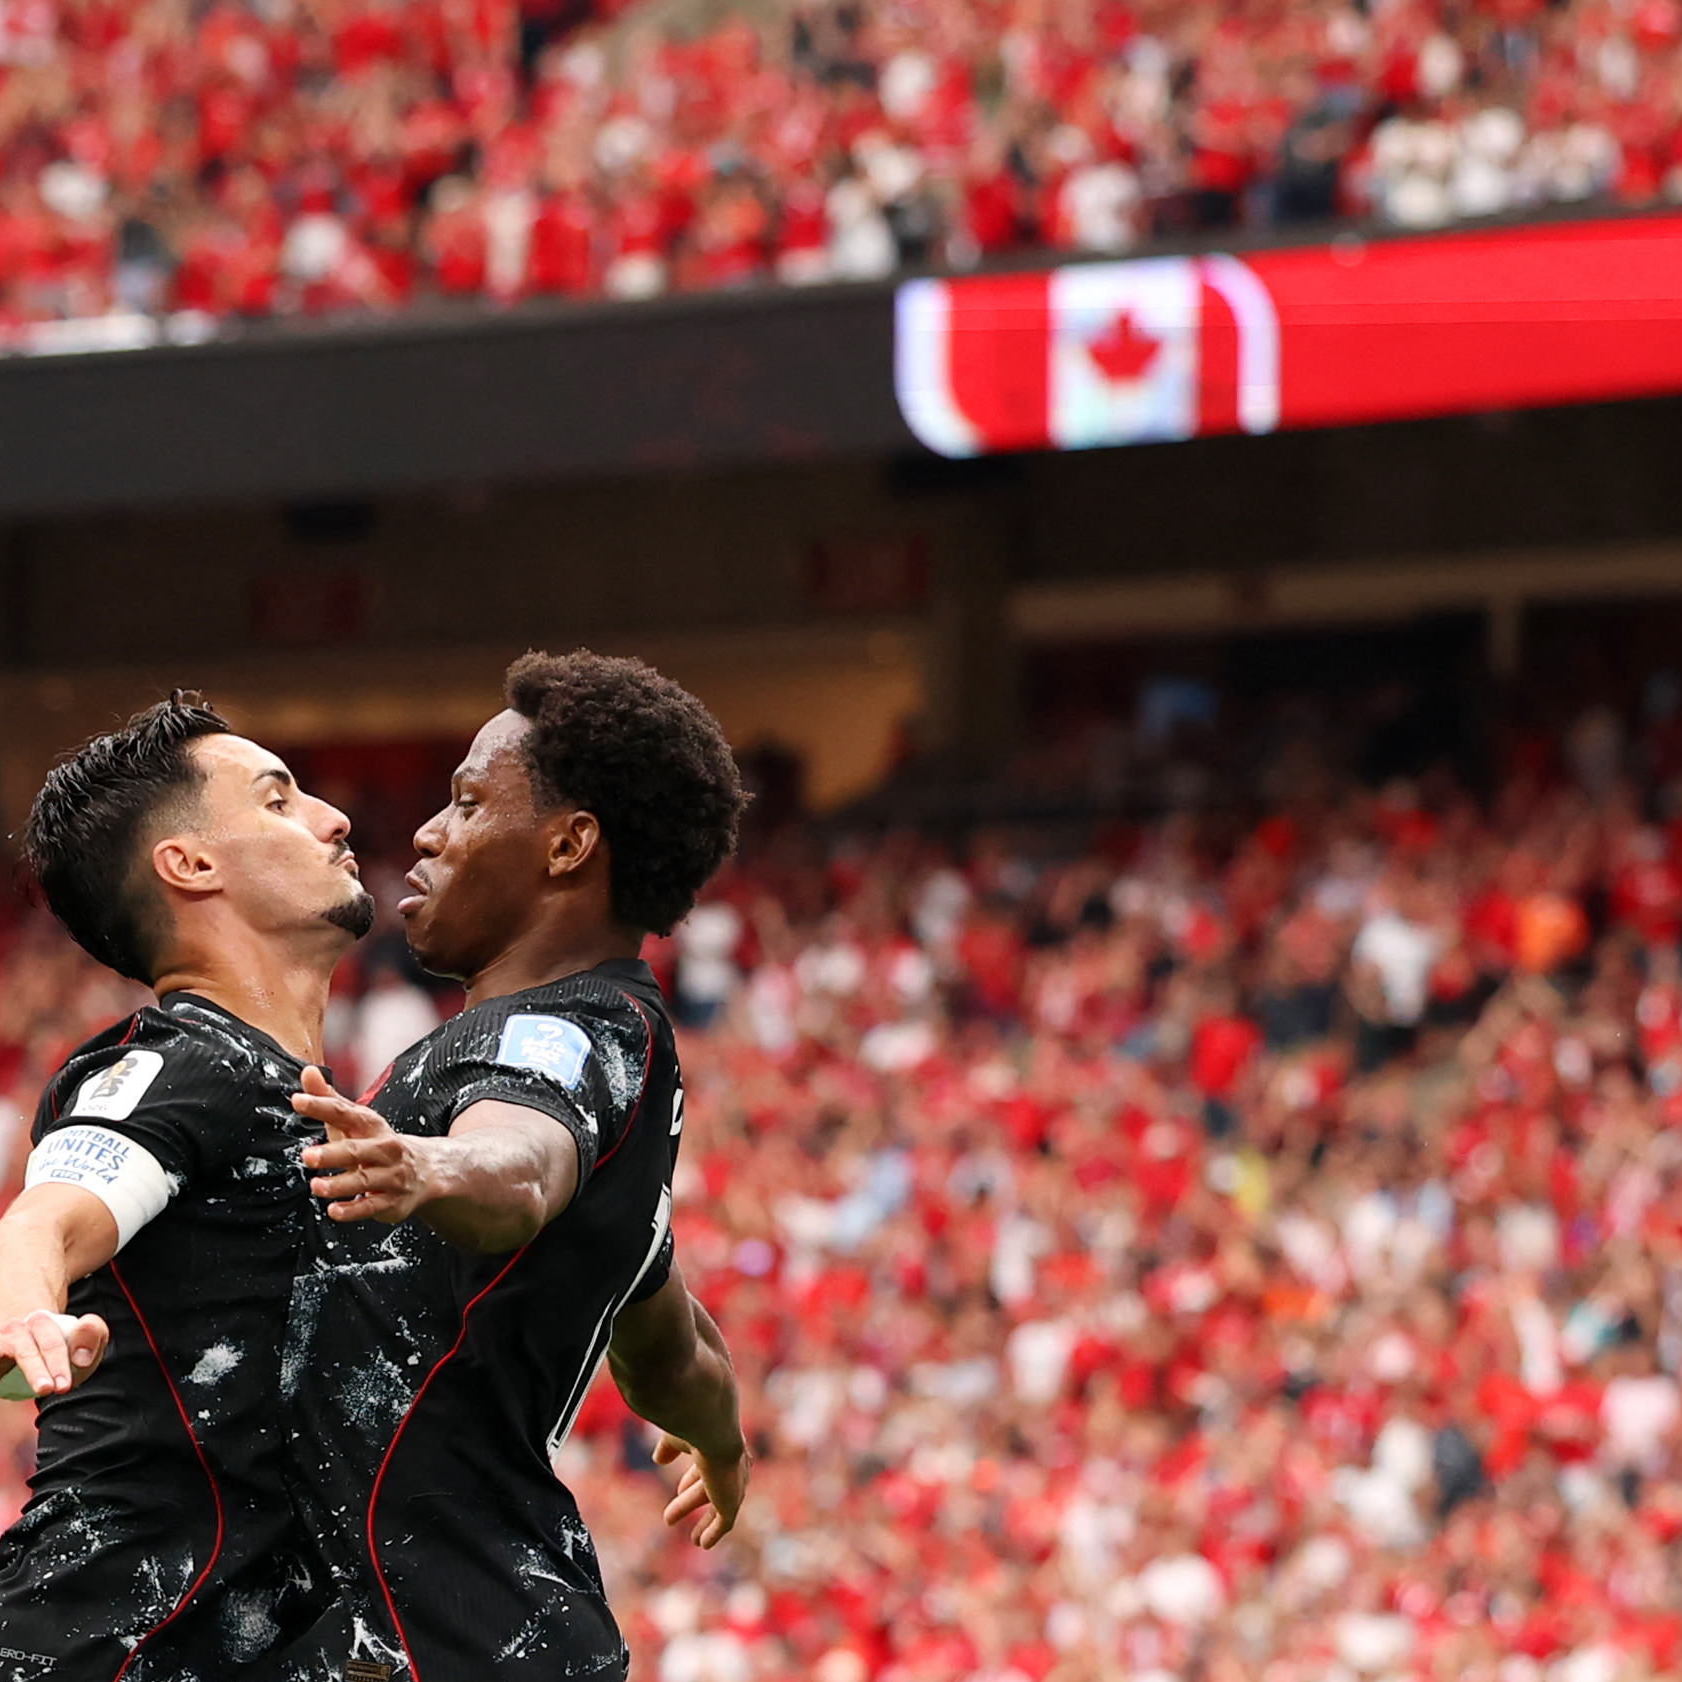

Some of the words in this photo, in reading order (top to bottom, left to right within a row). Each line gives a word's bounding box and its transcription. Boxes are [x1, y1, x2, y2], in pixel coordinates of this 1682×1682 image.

[521, 1045, 562, 1065] PEACE
[47, 1138, 124, 1171] UNITES
[63, 1154, 119, 1185] World
